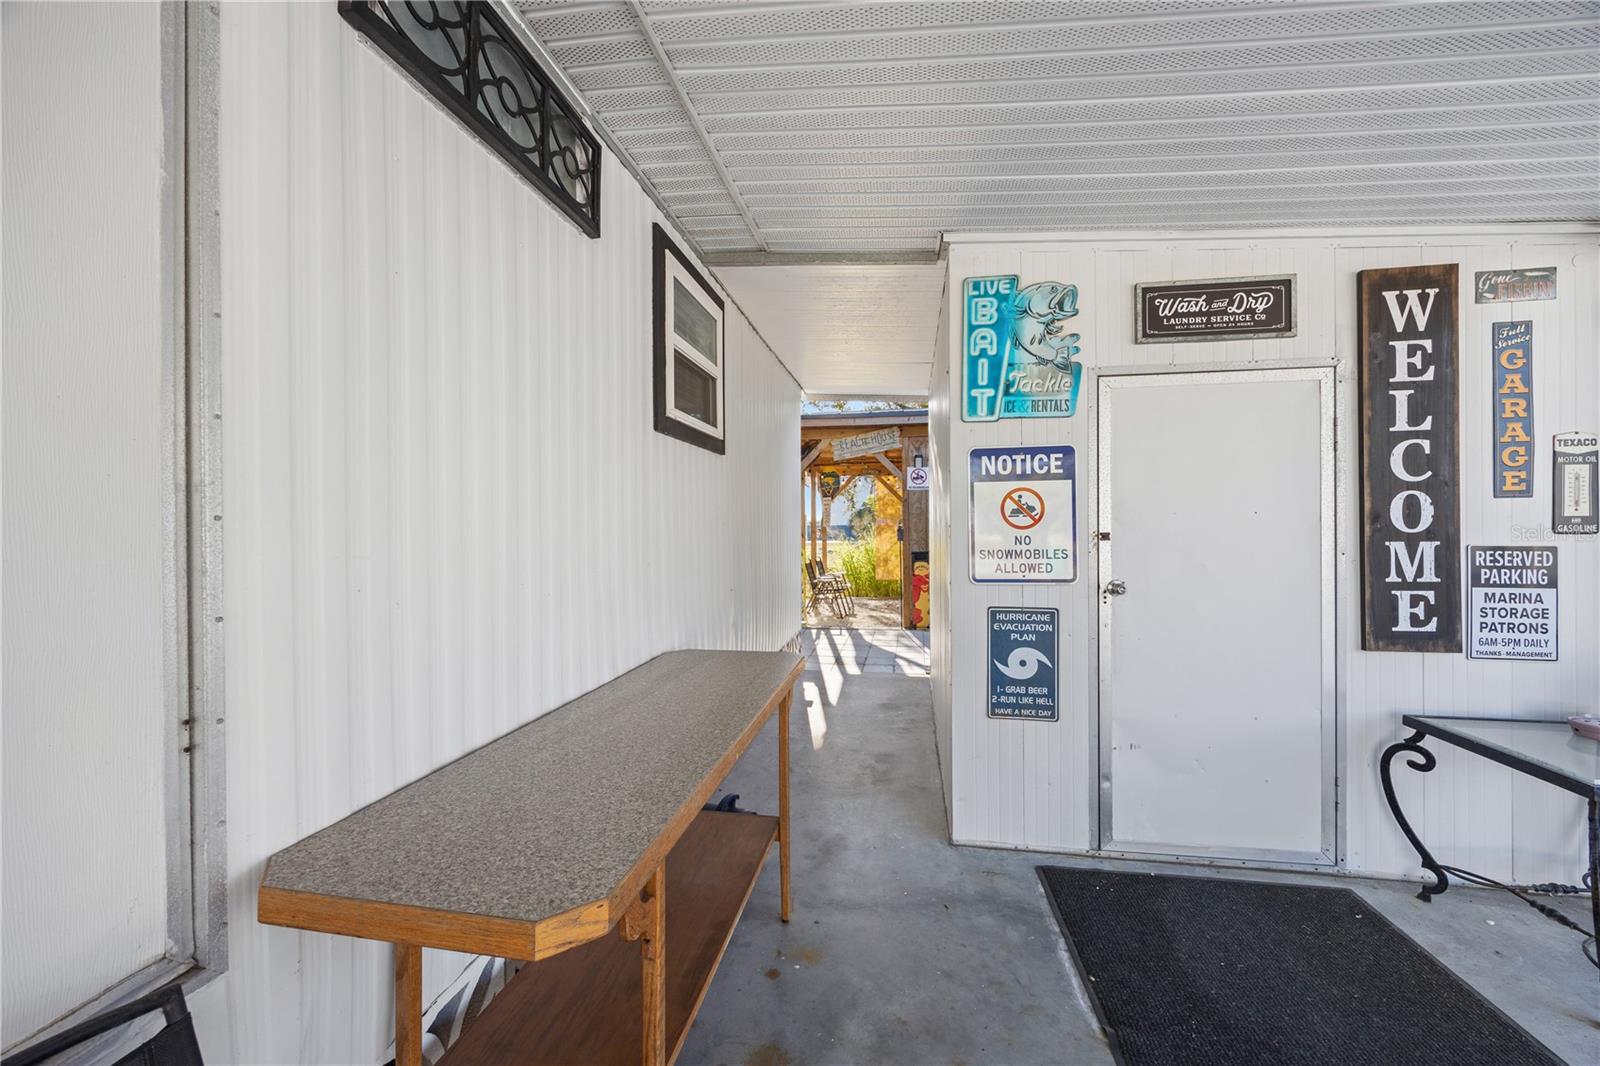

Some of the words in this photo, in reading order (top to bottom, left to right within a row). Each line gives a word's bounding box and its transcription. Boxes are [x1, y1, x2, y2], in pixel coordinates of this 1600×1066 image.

[969, 279, 1011, 296] LIVE
[1479, 272, 1520, 293] Gone
[1155, 294, 1209, 317] Wash
[1210, 298, 1229, 310] and
[1227, 291, 1274, 314] Dry
[1163, 316, 1208, 325] LAUNDRY
[1210, 314, 1252, 323] SERVICE
[1499, 324, 1525, 339] Full
[1494, 334, 1532, 349] Service
[970, 297, 998, 417] BAIT
[1008, 371, 1073, 394] Tackle
[1003, 400, 1016, 413] ICE
[1018, 400, 1030, 413] &
[1031, 399, 1070, 413] RENTALS
[1498, 348, 1531, 492] GARAGE
[1556, 438, 1598, 448] TEXACO
[981, 453, 1064, 476] NOTICE
[1381, 286, 1441, 632] WELCOME
[1585, 455, 1598, 463] OIL
[1556, 524, 1598, 533] GASOLINE
[1014, 535, 1032, 546] NO
[979, 549, 1069, 560] SNOWMOBILES
[1475, 550, 1554, 567] RESERVED
[994, 563, 1054, 574] ALLOWED
[1480, 568, 1549, 585] PARKING
[1483, 592, 1544, 605] MARINA
[996, 613, 1051, 622] HURRICANE
[1479, 607, 1550, 620] STORAGE
[993, 623, 1053, 632] EVACUATION
[1479, 621, 1550, 635] PATRONS
[1010, 633, 1036, 641] PLAN
[1478, 637, 1521, 648] 6AM-5PM
[1523, 638, 1550, 648] DAILY
[1475, 649, 1502, 657] THANKS
[1506, 651, 1553, 659] MANAGEMENT
[1005, 686, 1026, 694] GRAB
[1028, 686, 1048, 695] BEER
[1018, 696, 1034, 705] LIKE
[1035, 698, 1054, 706] HELL
